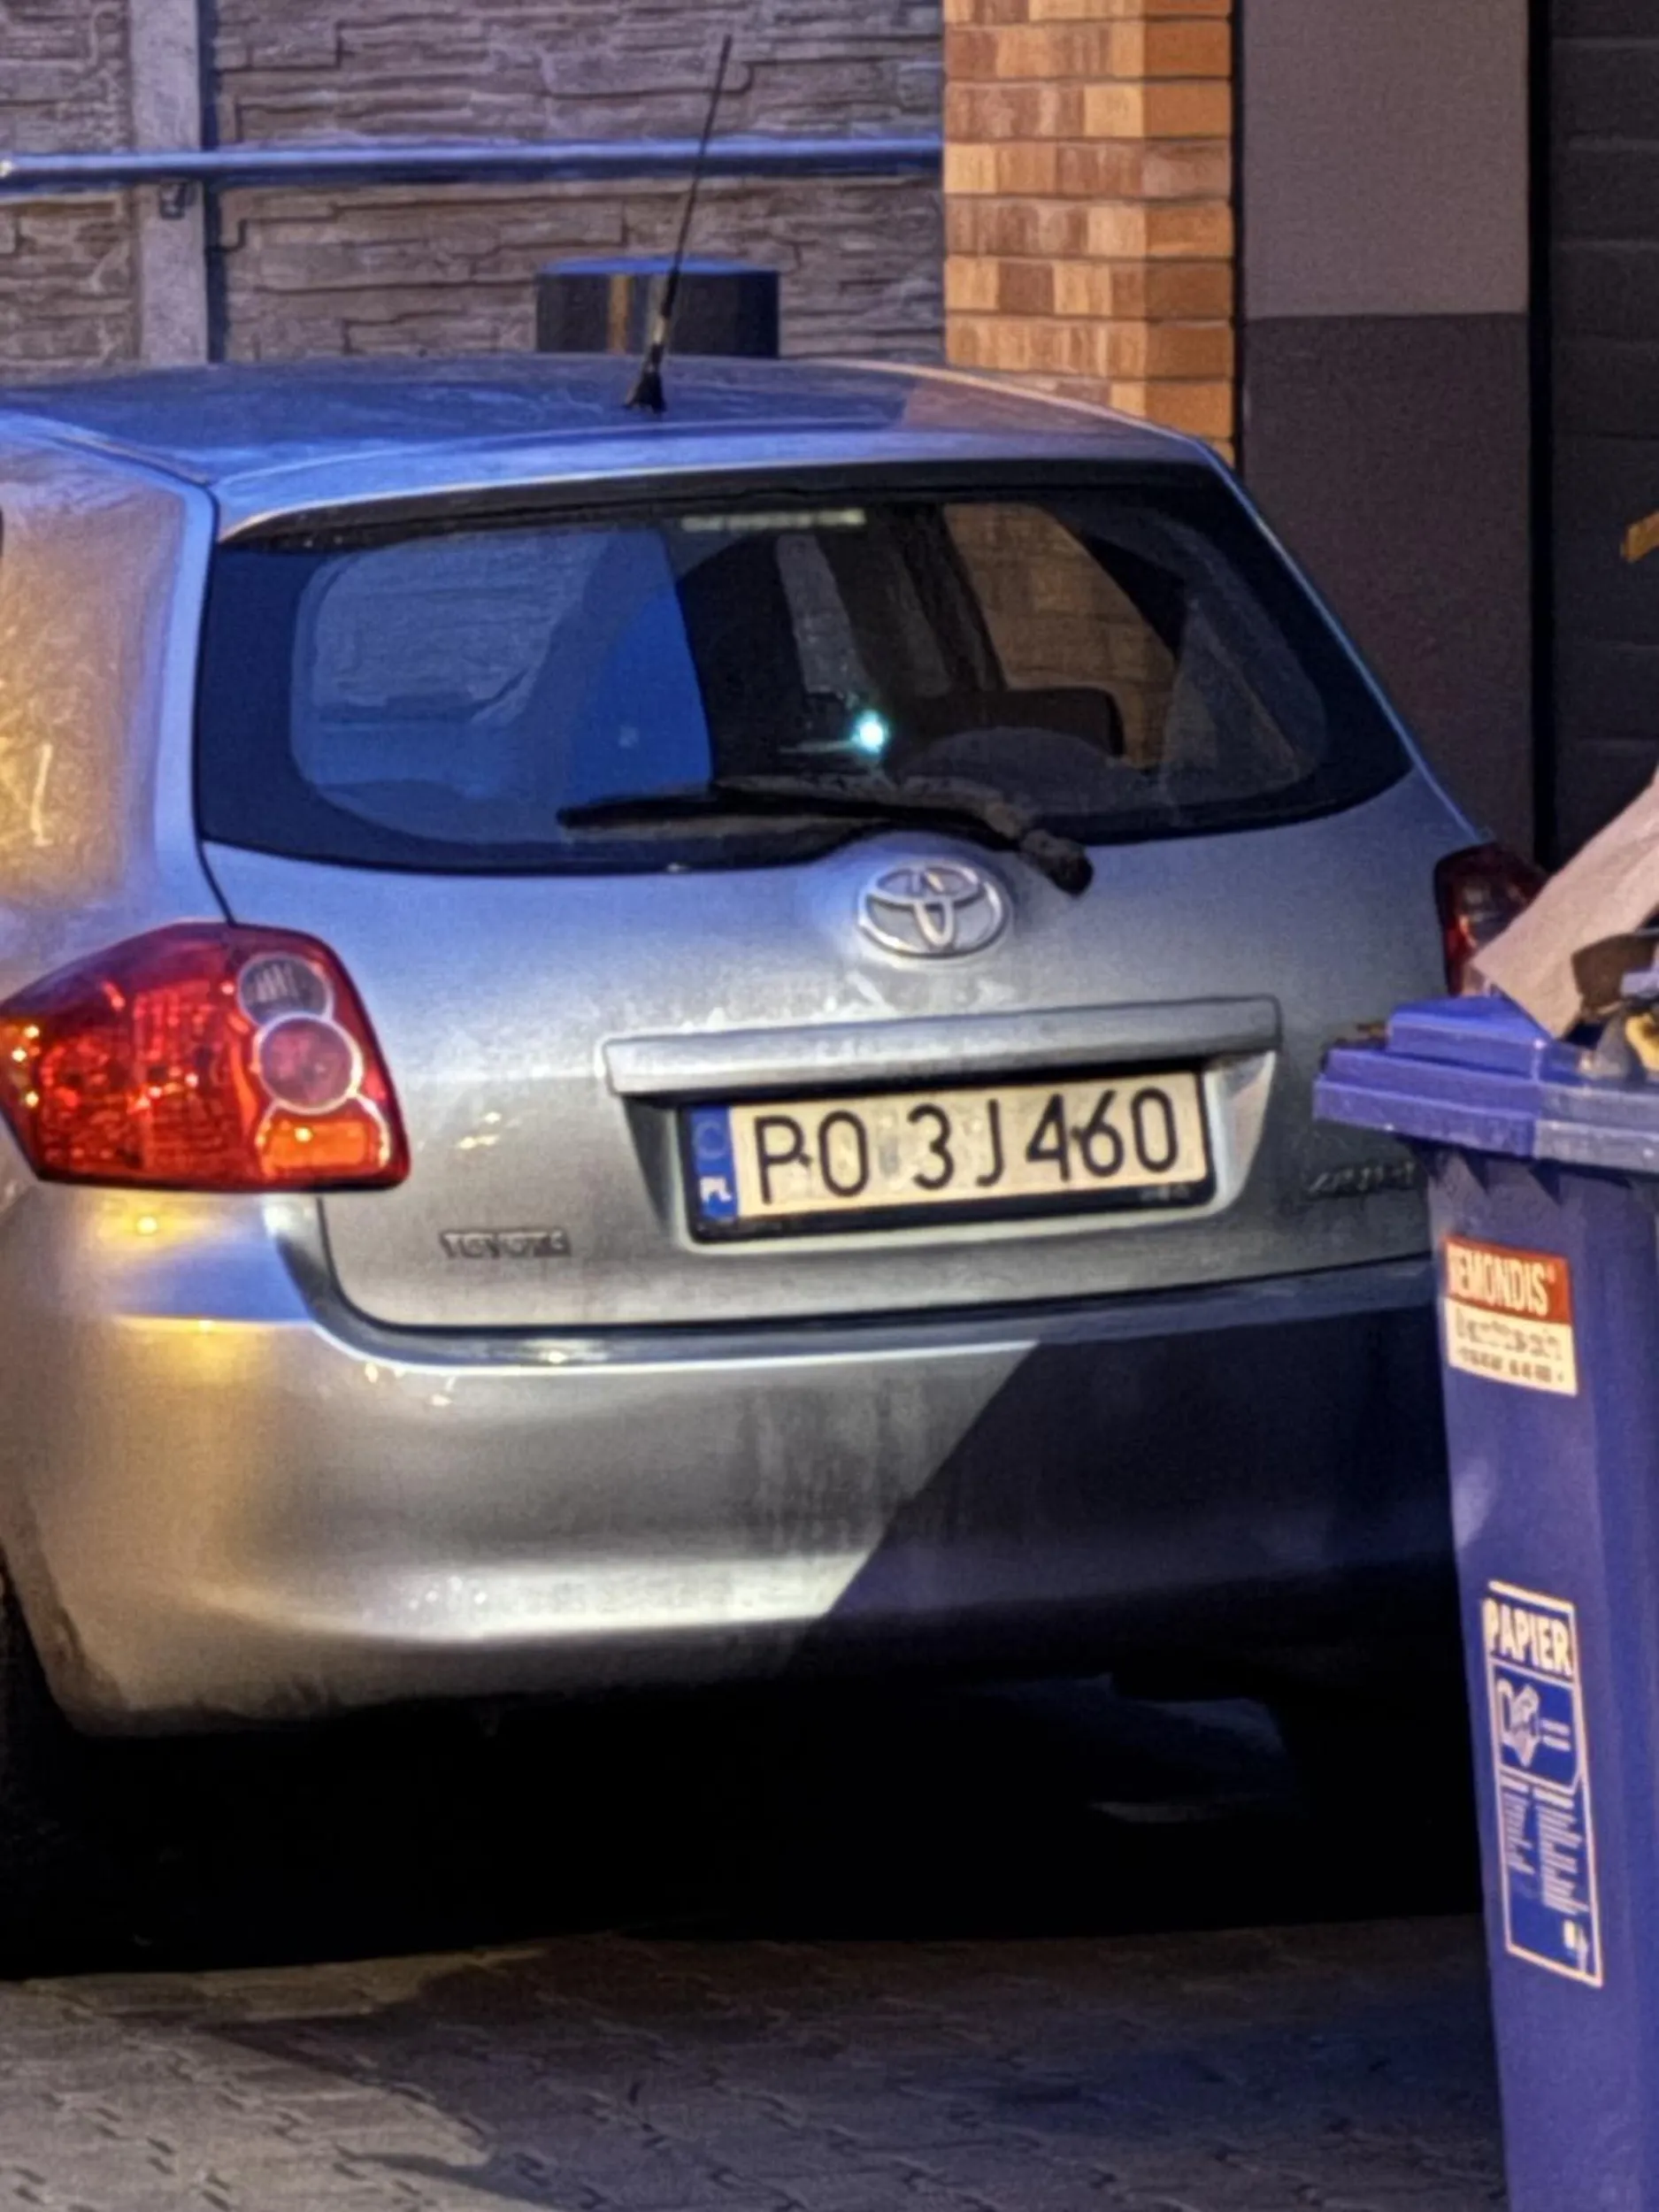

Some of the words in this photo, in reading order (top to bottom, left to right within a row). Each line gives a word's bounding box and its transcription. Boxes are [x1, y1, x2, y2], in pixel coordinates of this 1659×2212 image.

[754, 1110, 870, 1206] PO
[907, 1087, 1179, 1191] 3J460
[1482, 1598, 1573, 1676] PAPIER
